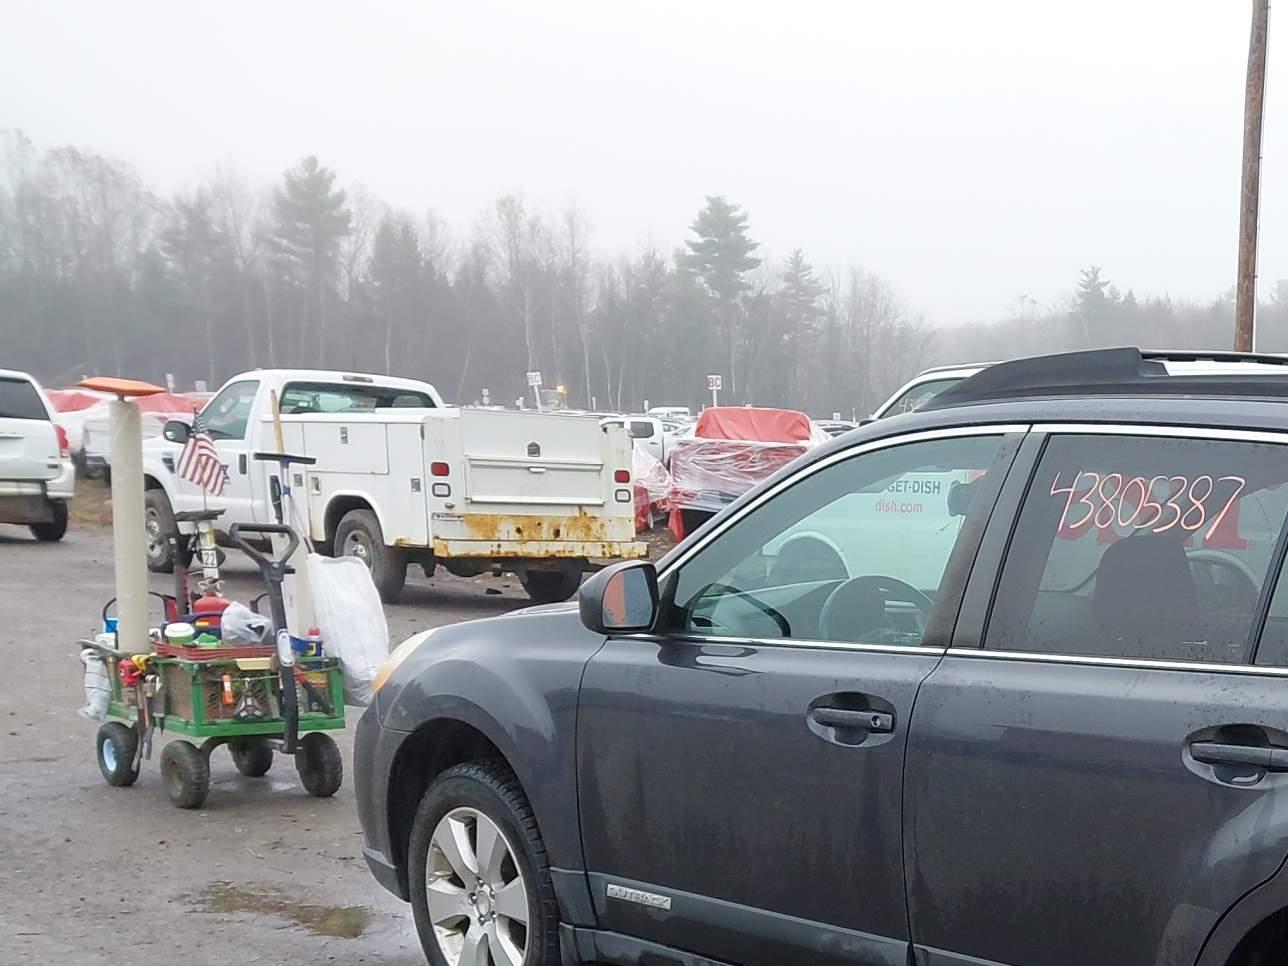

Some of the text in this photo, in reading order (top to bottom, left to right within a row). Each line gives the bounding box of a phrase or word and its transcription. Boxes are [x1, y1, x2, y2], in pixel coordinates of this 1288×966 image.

[875, 500, 923, 513] dish.com
[1050, 470, 1246, 540] 43805387
[204, 552, 215, 566] 22
